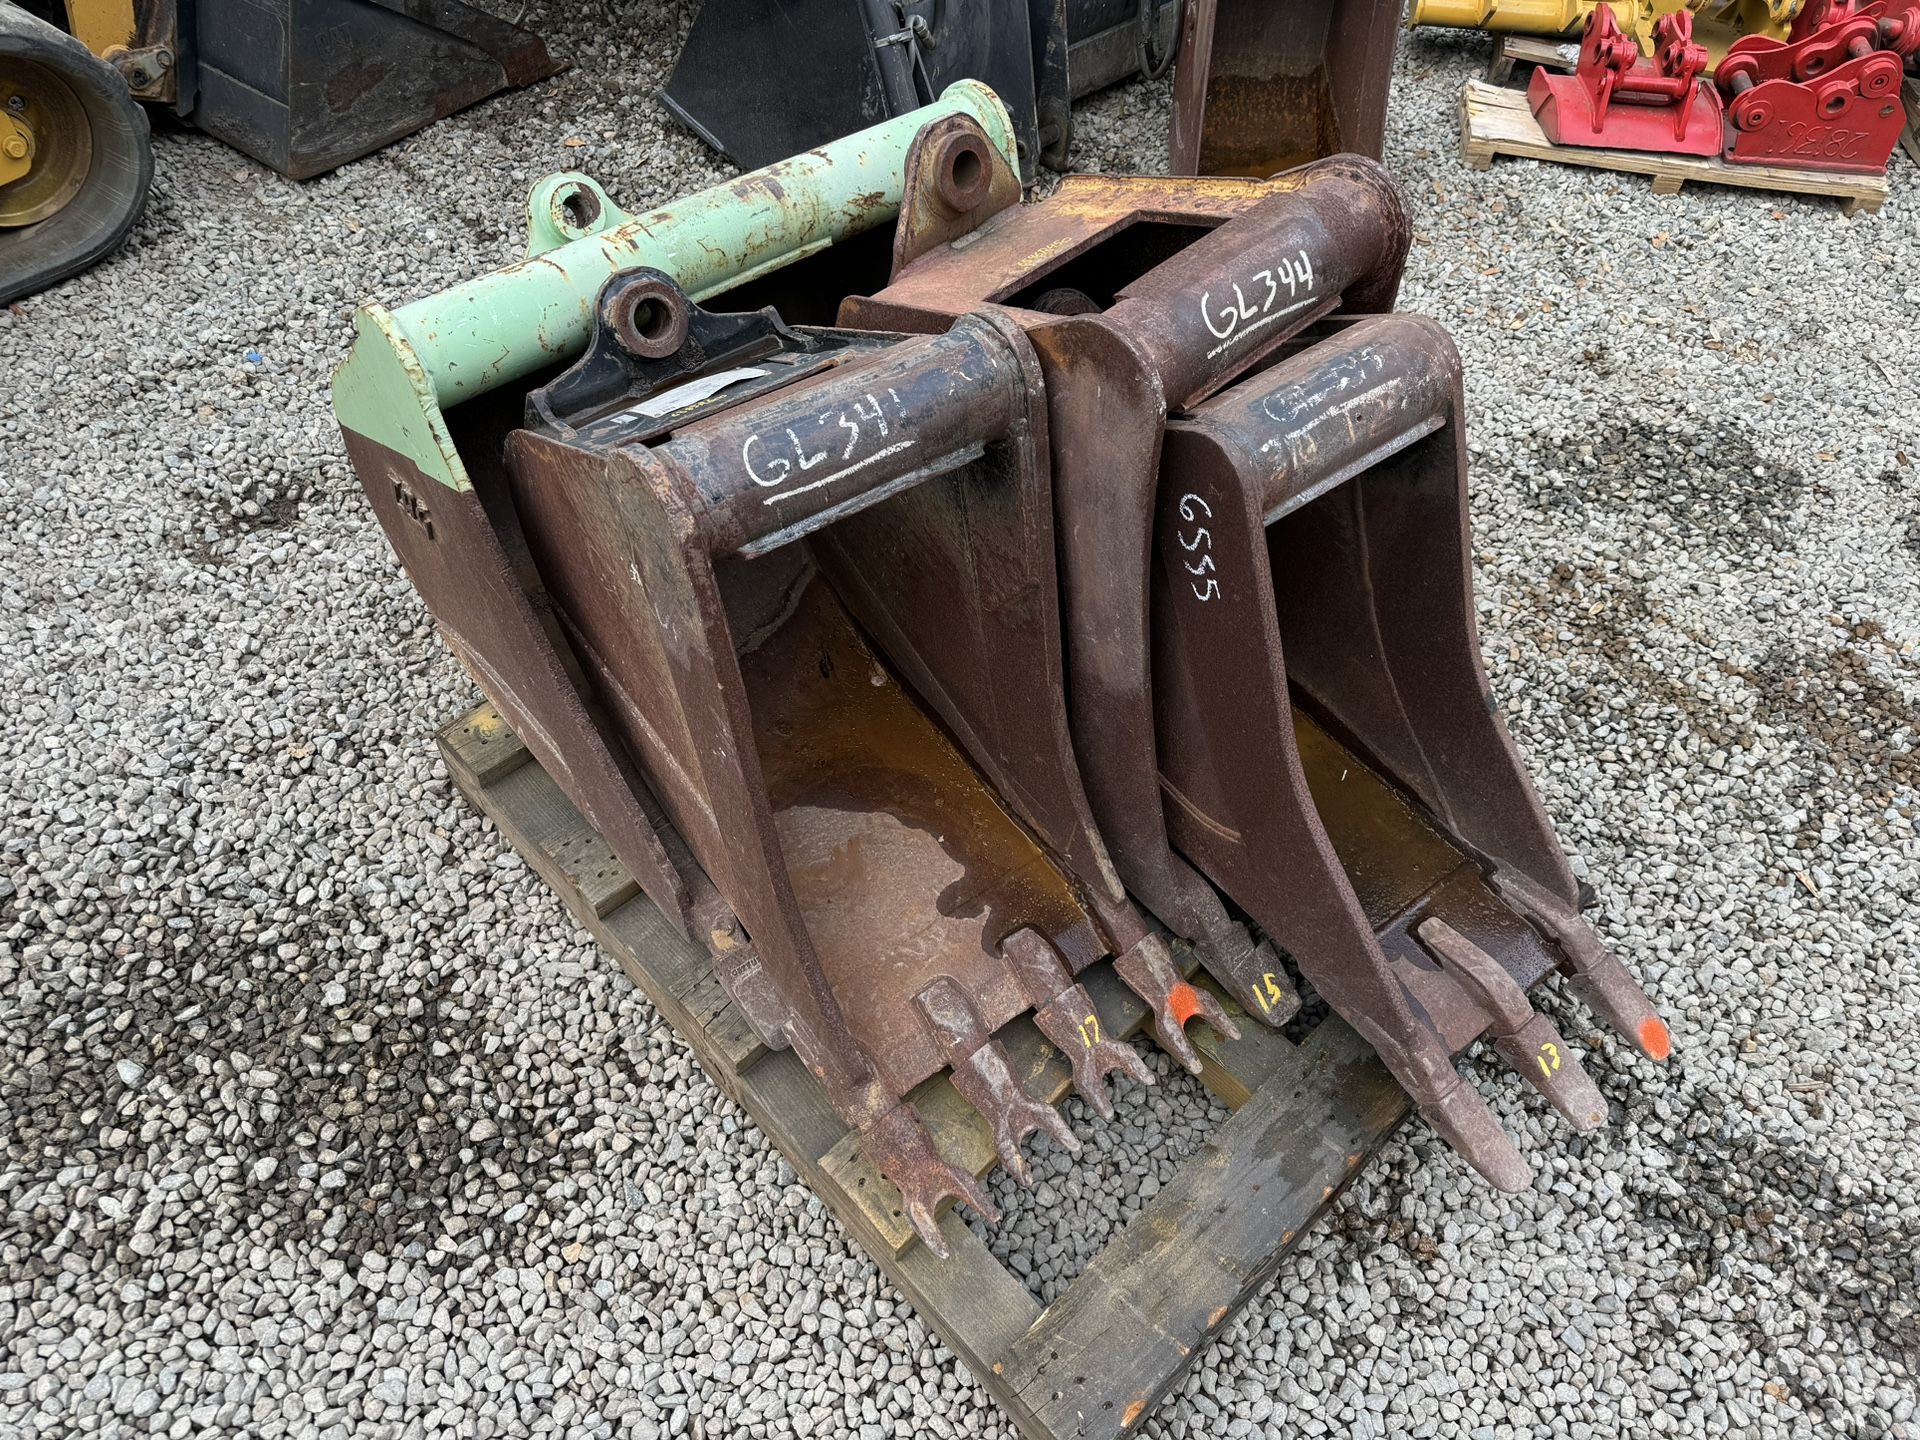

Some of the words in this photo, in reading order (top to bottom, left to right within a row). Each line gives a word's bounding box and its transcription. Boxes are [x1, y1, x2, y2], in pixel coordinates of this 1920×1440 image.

[1201, 250, 1314, 339] GL344
[1177, 493, 1220, 601] 6555
[1252, 972, 1282, 1014] 15
[1078, 1014, 1100, 1049] 17
[1537, 1042, 1561, 1078] 13
